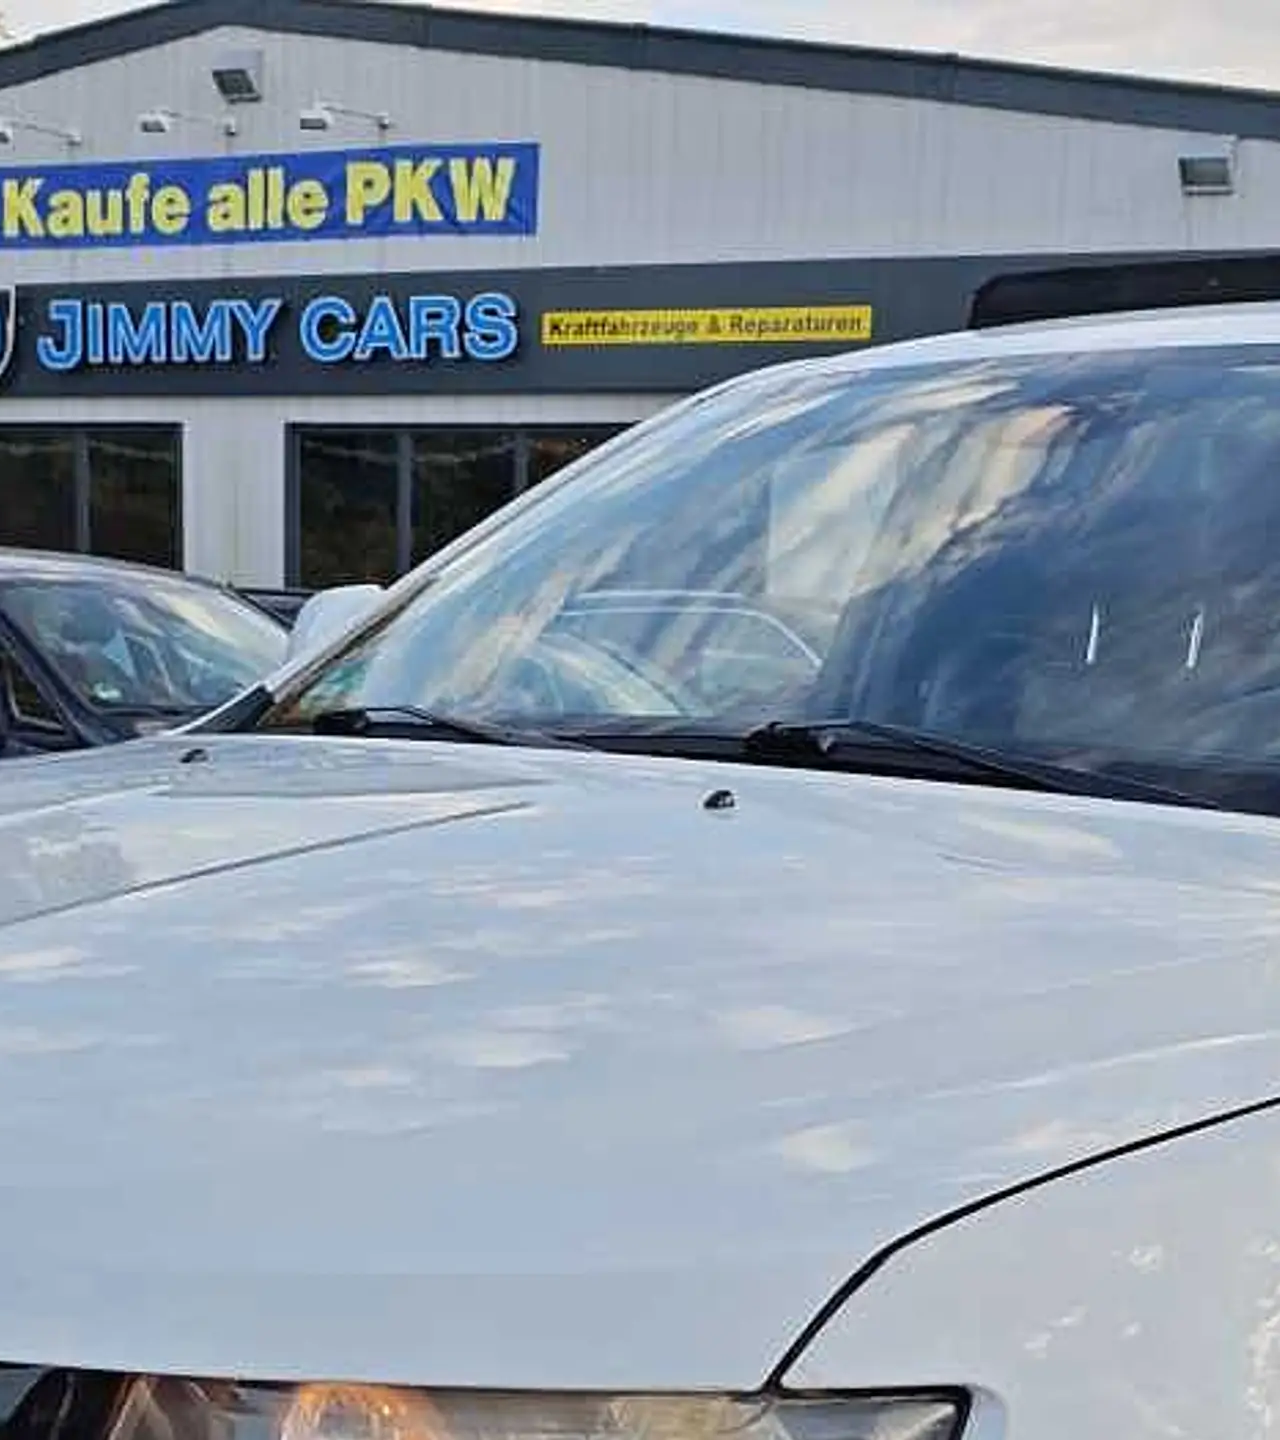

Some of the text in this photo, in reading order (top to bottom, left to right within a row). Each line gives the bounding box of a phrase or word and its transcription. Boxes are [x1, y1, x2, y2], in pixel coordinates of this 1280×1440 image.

[2, 157, 516, 237] Kaufe alle PKW
[36, 293, 518, 371] JIMMY CARS
[549, 313, 862, 340] Kraftfahrzeuge & Reparaturen
